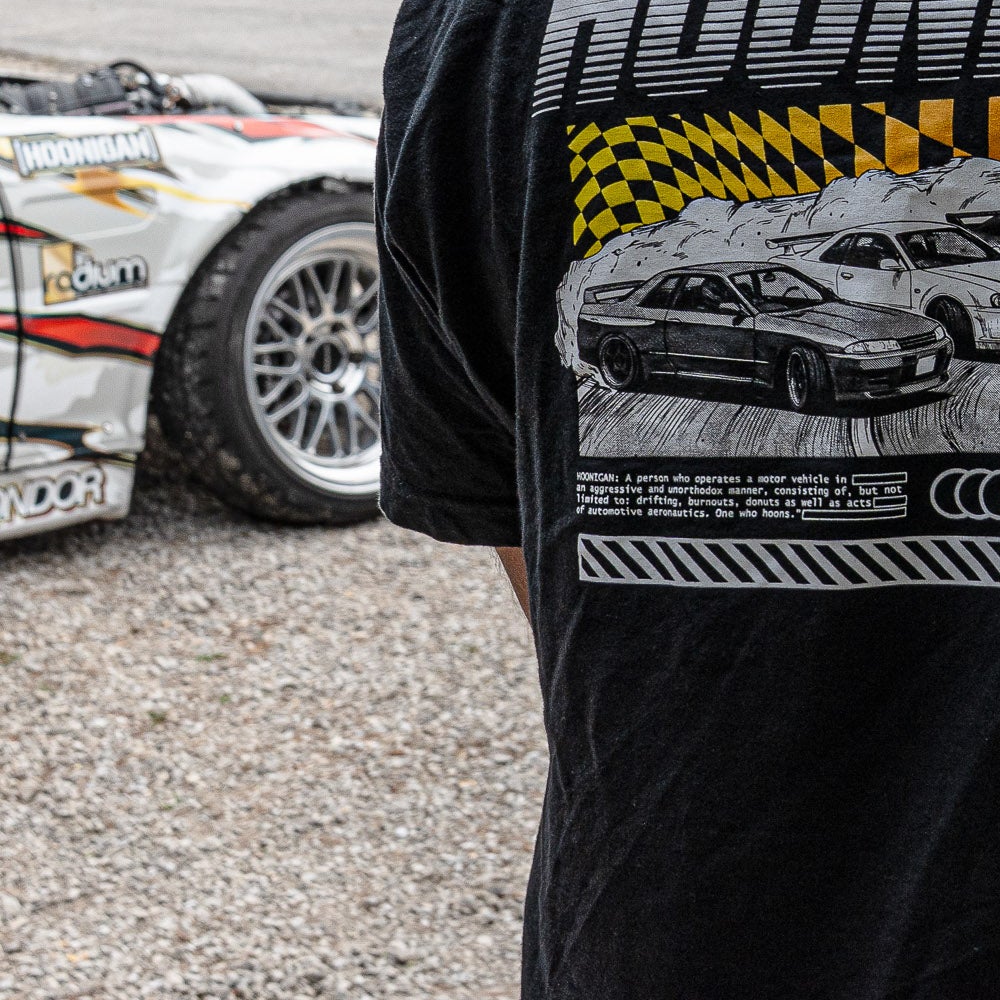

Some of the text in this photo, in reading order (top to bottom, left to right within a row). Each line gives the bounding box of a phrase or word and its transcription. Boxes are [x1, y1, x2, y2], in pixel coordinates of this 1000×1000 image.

[22, 130, 150, 170] HOONIGAN
[576, 472, 847, 484] HOONIGAN: A person who operates a motor vehicle in
[0, 467, 104, 520] NDOR
[576, 484, 902, 497] an aggressive and unorthodox manner, consisting of, but not
[576, 494, 872, 507] limited to: drifting, burnouts, donuts as well as acts
[576, 505, 585, 514] of
[588, 507, 643, 515] automotive
[647, 508, 710, 517] aeronautics.
[715, 508, 734, 518] One
[739, 508, 758, 518] who
